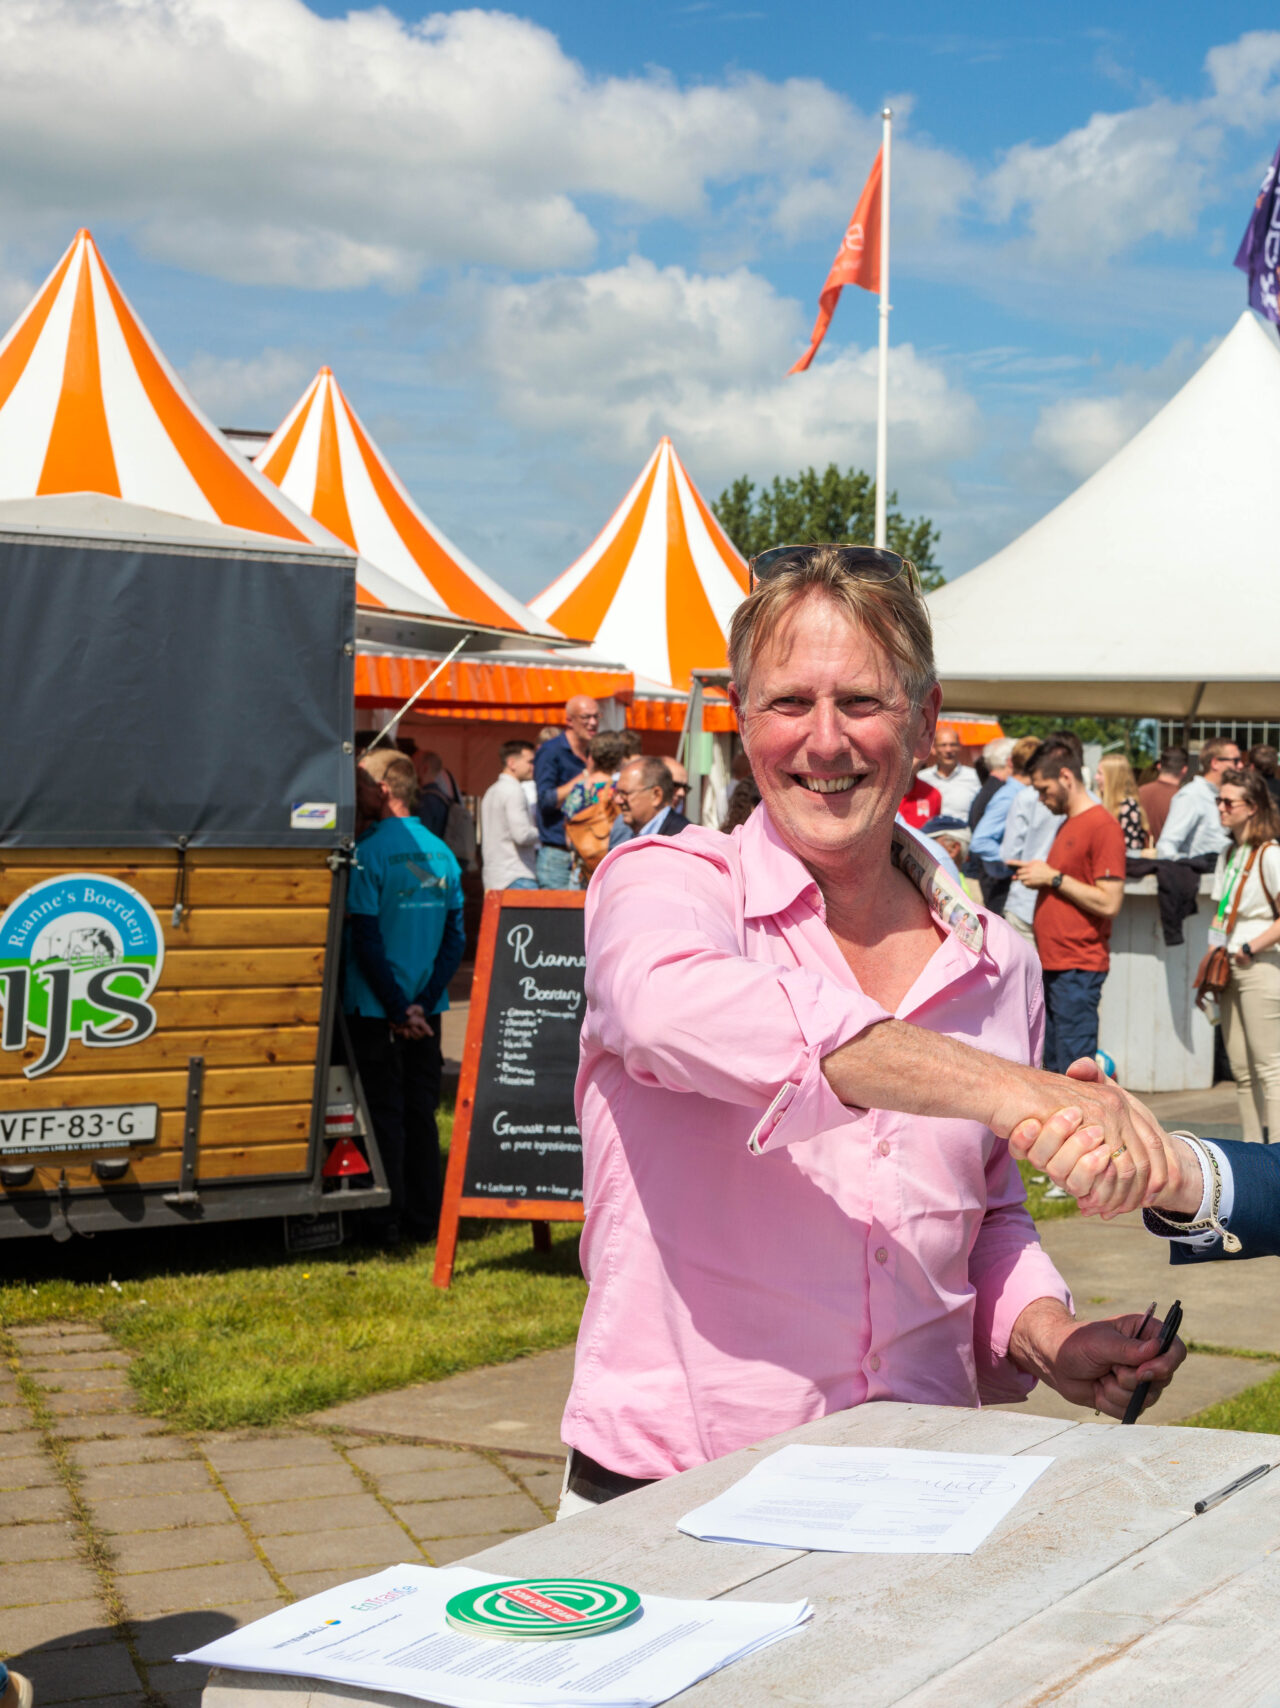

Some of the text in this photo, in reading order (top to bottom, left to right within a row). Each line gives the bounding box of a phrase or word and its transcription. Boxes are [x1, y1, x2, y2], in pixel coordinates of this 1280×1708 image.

[8, 887, 149, 949] Rianne's Boerderij
[0, 1111, 135, 1142] VFF-83-G
[508, 1589, 536, 1601] JOIN
[529, 1598, 553, 1610] OUR
